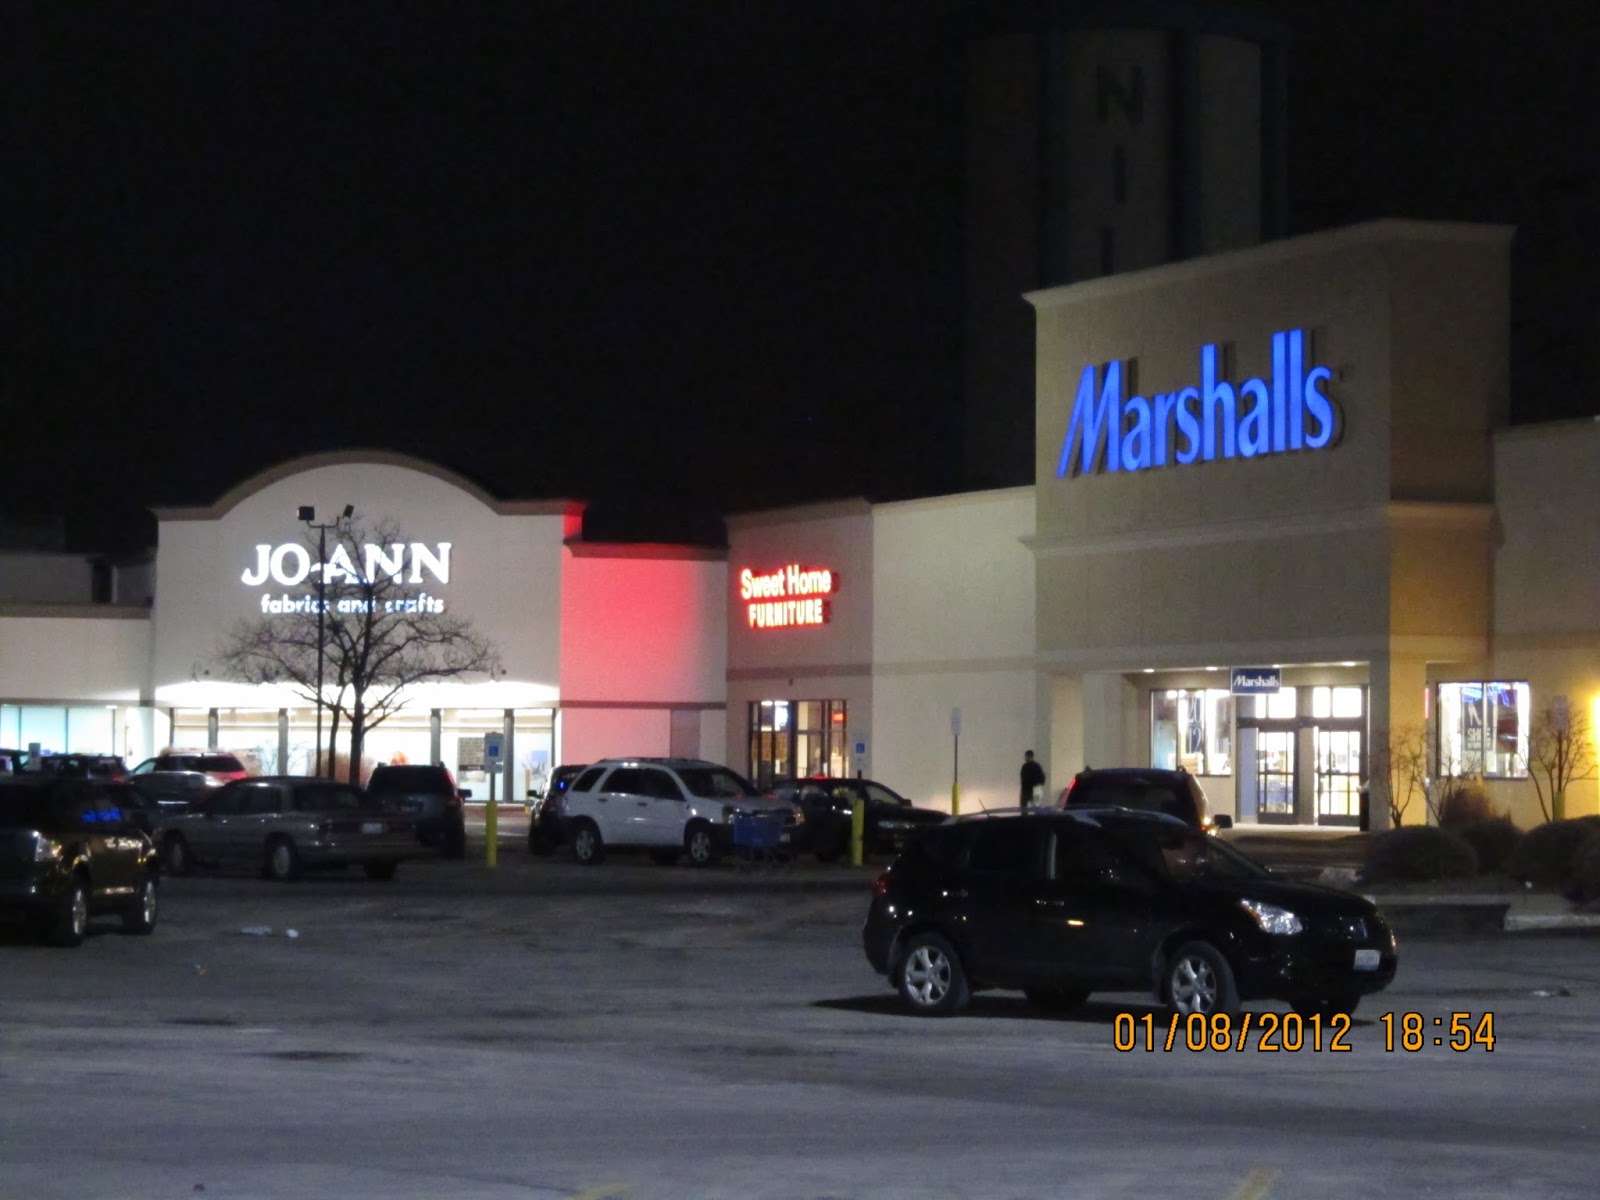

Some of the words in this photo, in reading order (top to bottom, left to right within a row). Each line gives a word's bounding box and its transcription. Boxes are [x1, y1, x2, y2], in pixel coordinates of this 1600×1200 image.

[1056, 328, 1334, 479] Marshalls
[741, 567, 785, 600] Sweet
[787, 564, 832, 595] Home
[261, 593, 330, 614] fabrics
[385, 592, 445, 614] crafts
[748, 598, 823, 628] FURNITURE
[1233, 675, 1280, 687] Marshalls
